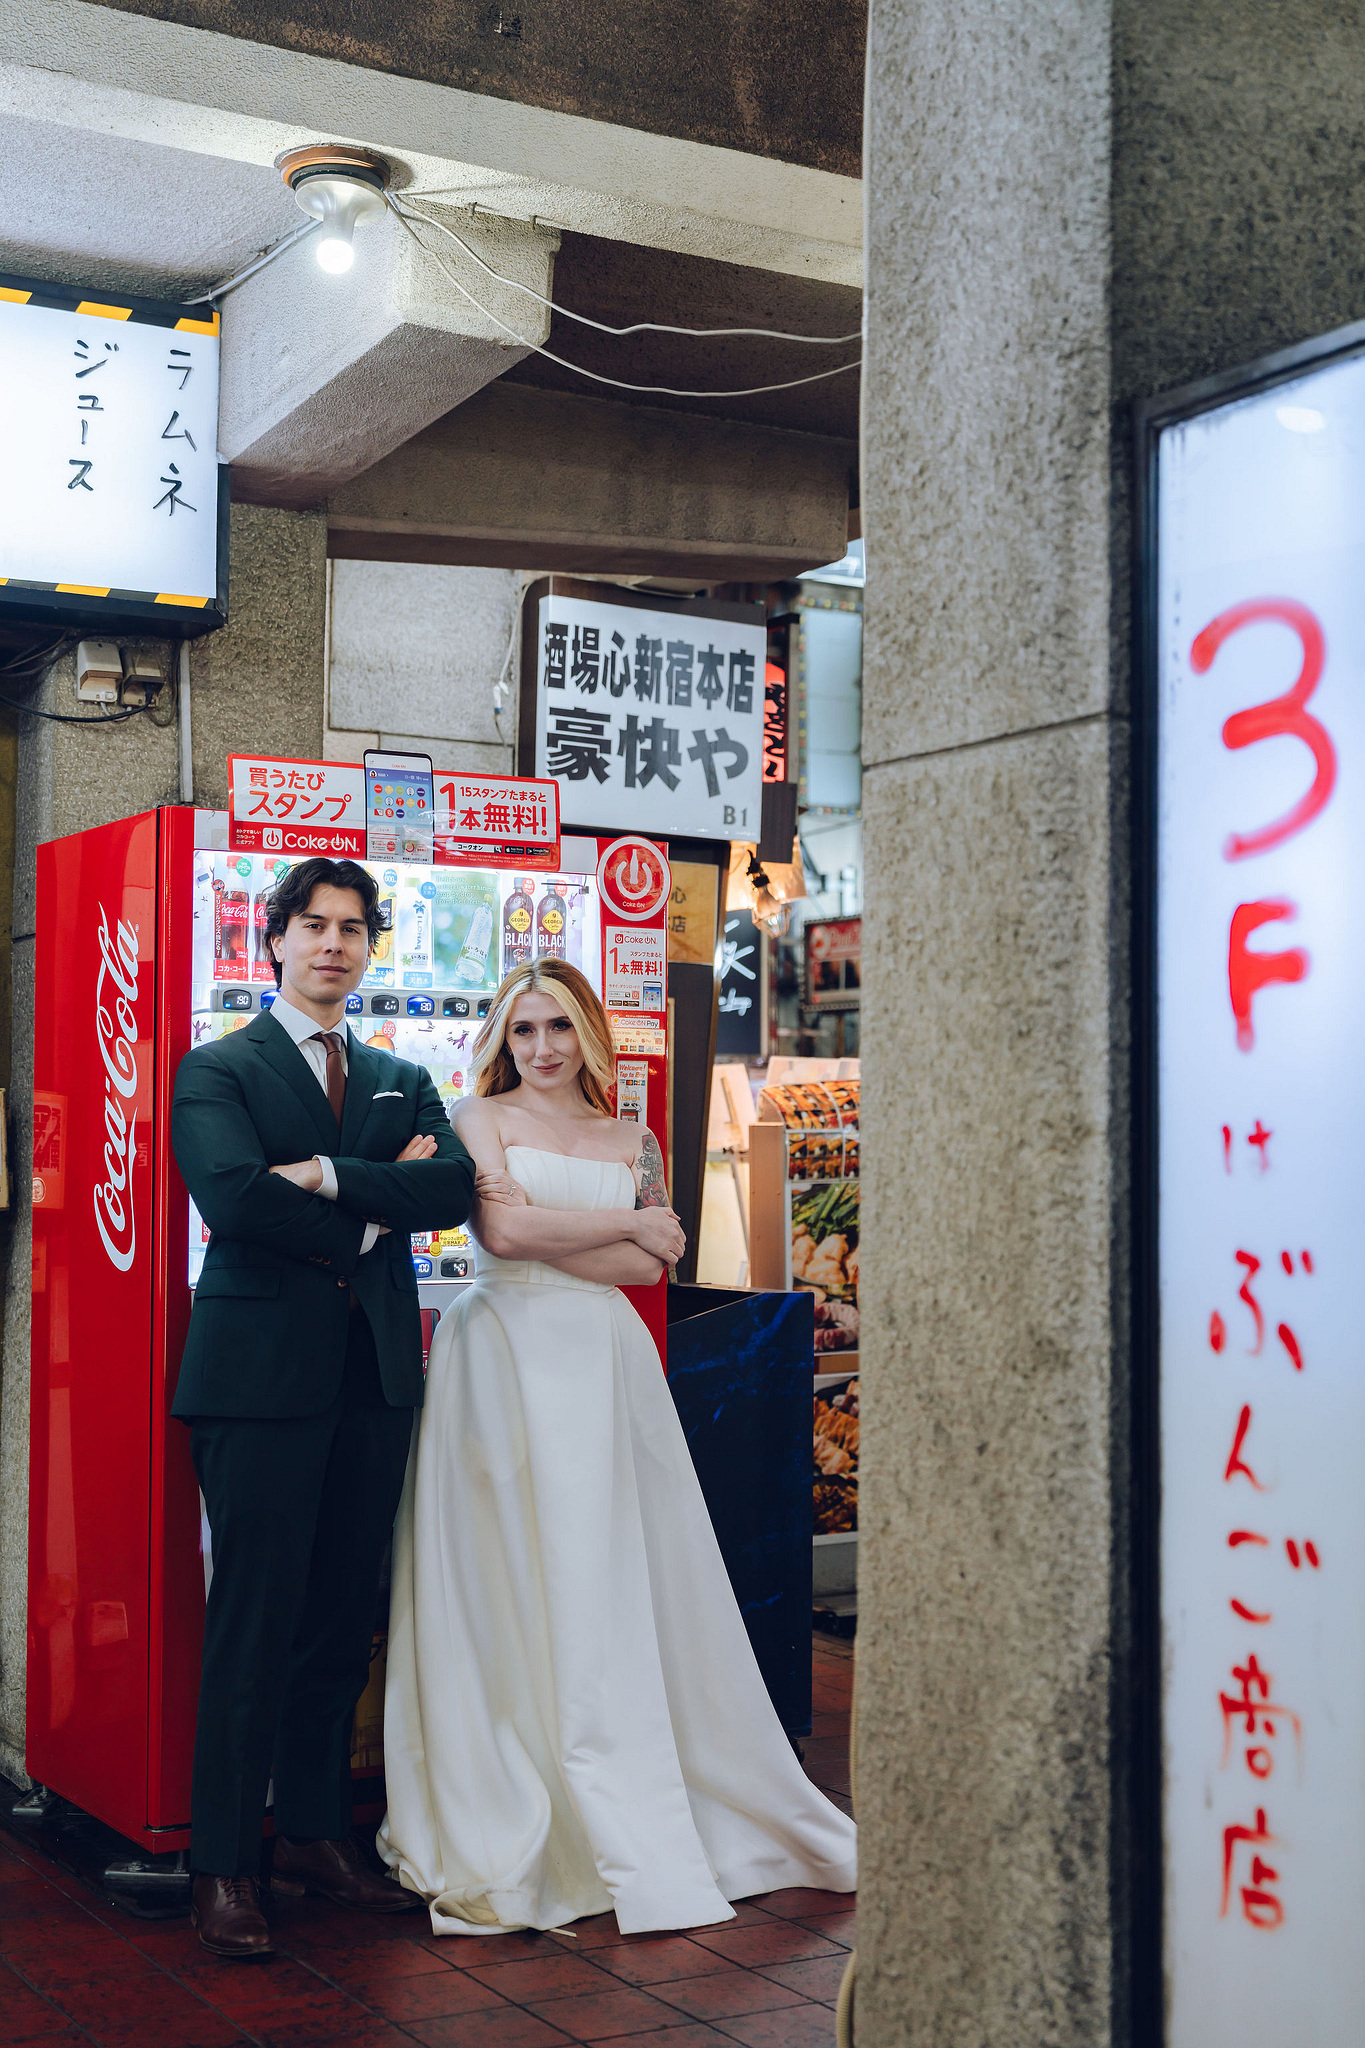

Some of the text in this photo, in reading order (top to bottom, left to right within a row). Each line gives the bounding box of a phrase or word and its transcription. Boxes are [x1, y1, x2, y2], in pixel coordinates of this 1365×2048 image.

[67, 339, 119, 491] ジュース
[153, 349, 197, 517] ラムネ
[544, 622, 755, 714] 酒場心新宿本店
[546, 706, 749, 798] 豪快や
[249, 767, 325, 791] 買うたび
[460, 786, 547, 803] 15スタンプたまると
[248, 790, 352, 822] スタンプ
[723, 805, 748, 827] B1
[284, 832, 328, 849] Coke
[668, 915, 687, 933] 店
[505, 932, 532, 947] BLACK
[539, 934, 566, 948] BLACK
[624, 935, 643, 944] Coke
[646, 1020, 658, 1028] Pay
[94, 902, 139, 1272] Coca-Cola
